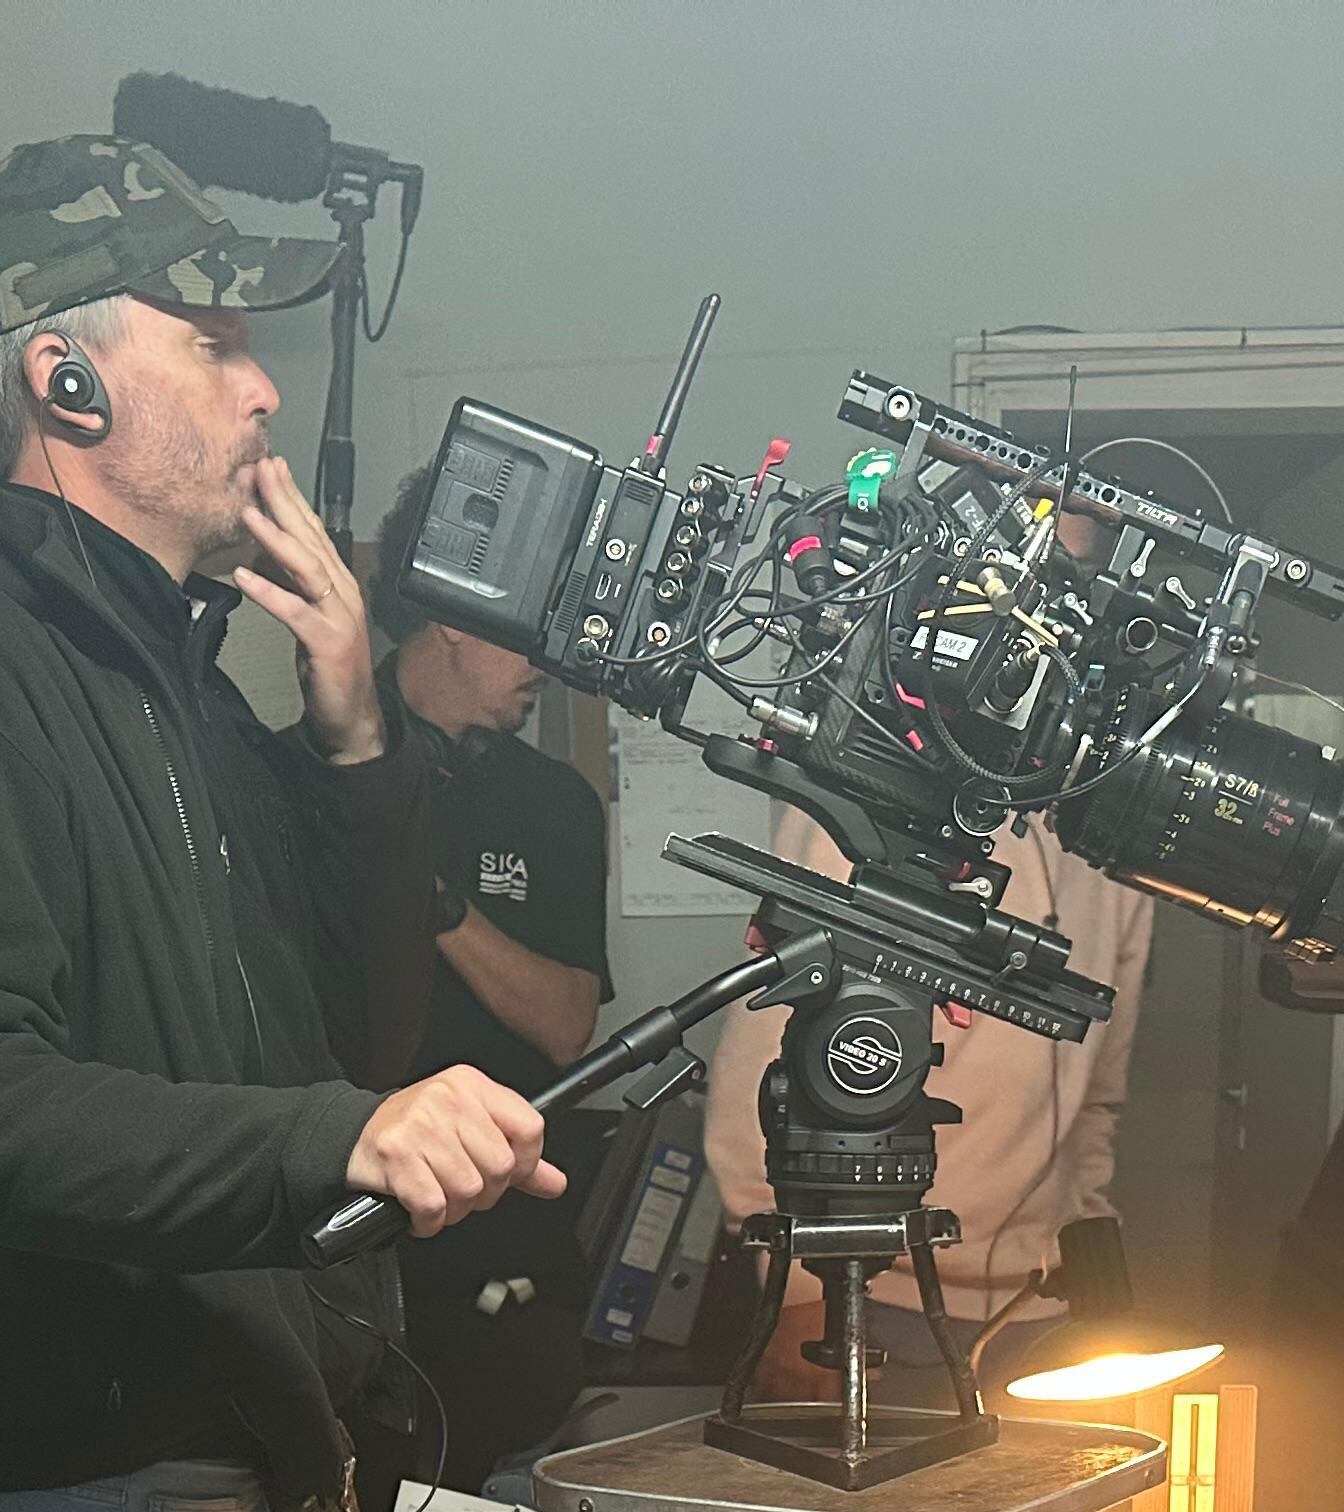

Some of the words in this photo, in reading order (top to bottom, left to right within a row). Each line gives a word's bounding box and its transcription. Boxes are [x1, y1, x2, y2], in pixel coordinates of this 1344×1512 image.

[1137, 502, 1177, 525] TILTA
[839, 1041, 866, 1058] VIDEO
[866, 1052, 878, 1063] 20
